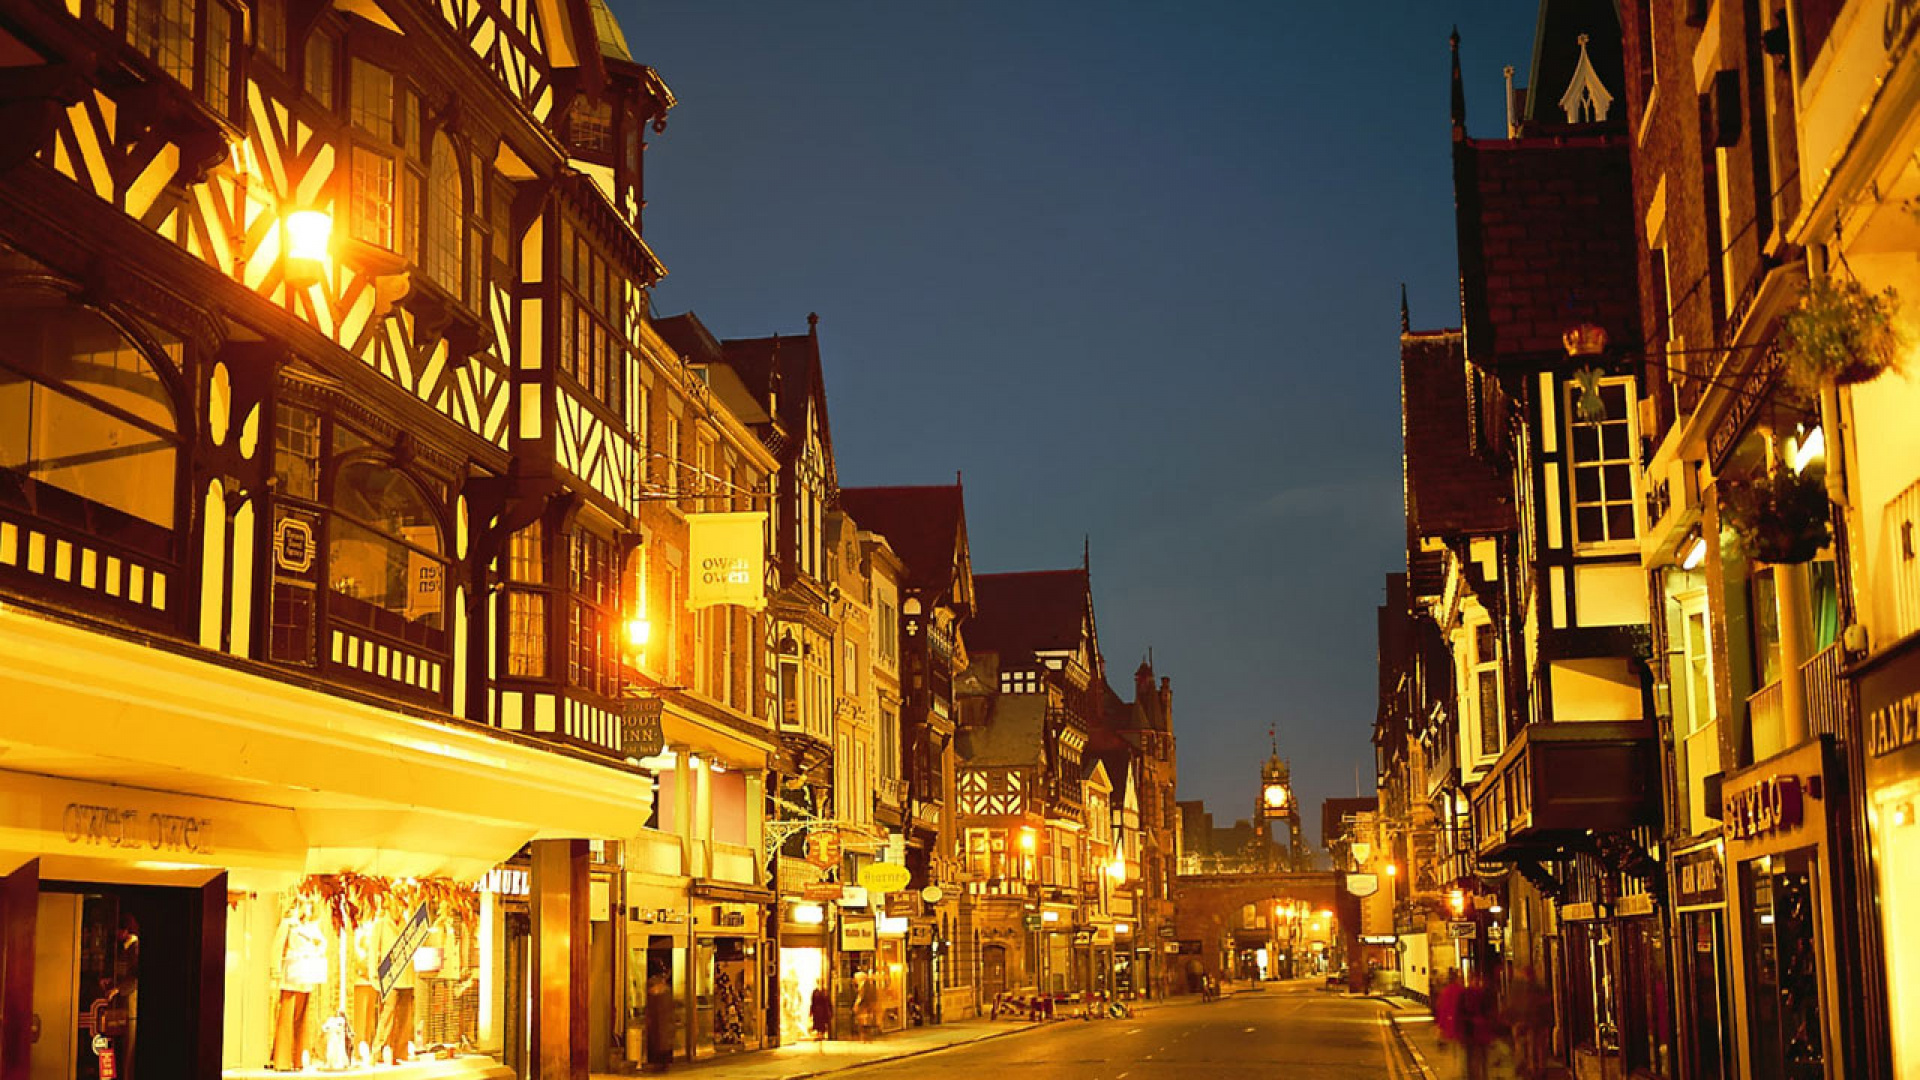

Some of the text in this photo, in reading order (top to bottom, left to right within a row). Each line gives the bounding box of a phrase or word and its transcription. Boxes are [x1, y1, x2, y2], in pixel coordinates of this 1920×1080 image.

[702, 557, 749, 570] owen
[702, 572, 749, 584] owen
[1722, 774, 1783, 842] STYLO
[63, 803, 216, 856] owen owen
